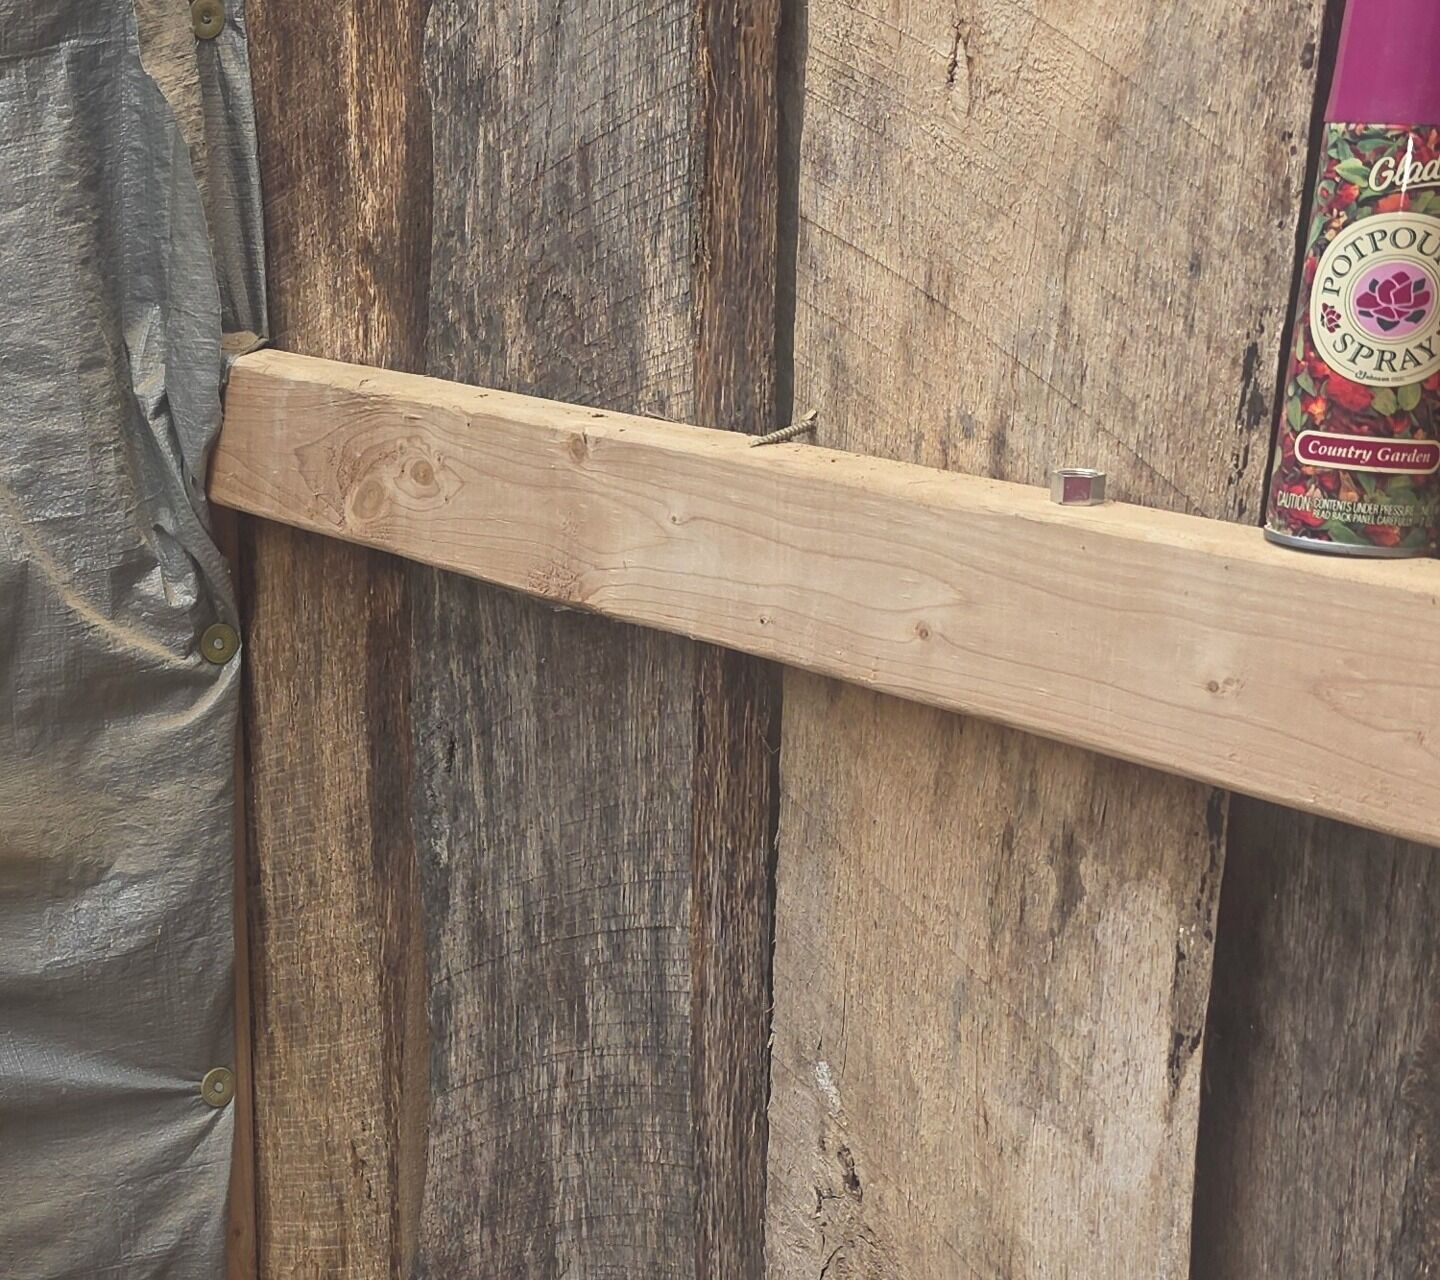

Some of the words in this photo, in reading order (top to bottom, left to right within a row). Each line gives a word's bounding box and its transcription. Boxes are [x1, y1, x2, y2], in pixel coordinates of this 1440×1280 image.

[1322, 226, 1440, 297] POTPOU
[1332, 332, 1438, 373] SPRAY
[1307, 440, 1372, 464] Country
[1377, 447, 1431, 463] Garden
[1313, 497, 1352, 512] CONTENTS
[1353, 502, 1379, 515] UNDER
[1332, 511, 1351, 523] BACK
[1352, 513, 1375, 525] PANEL
